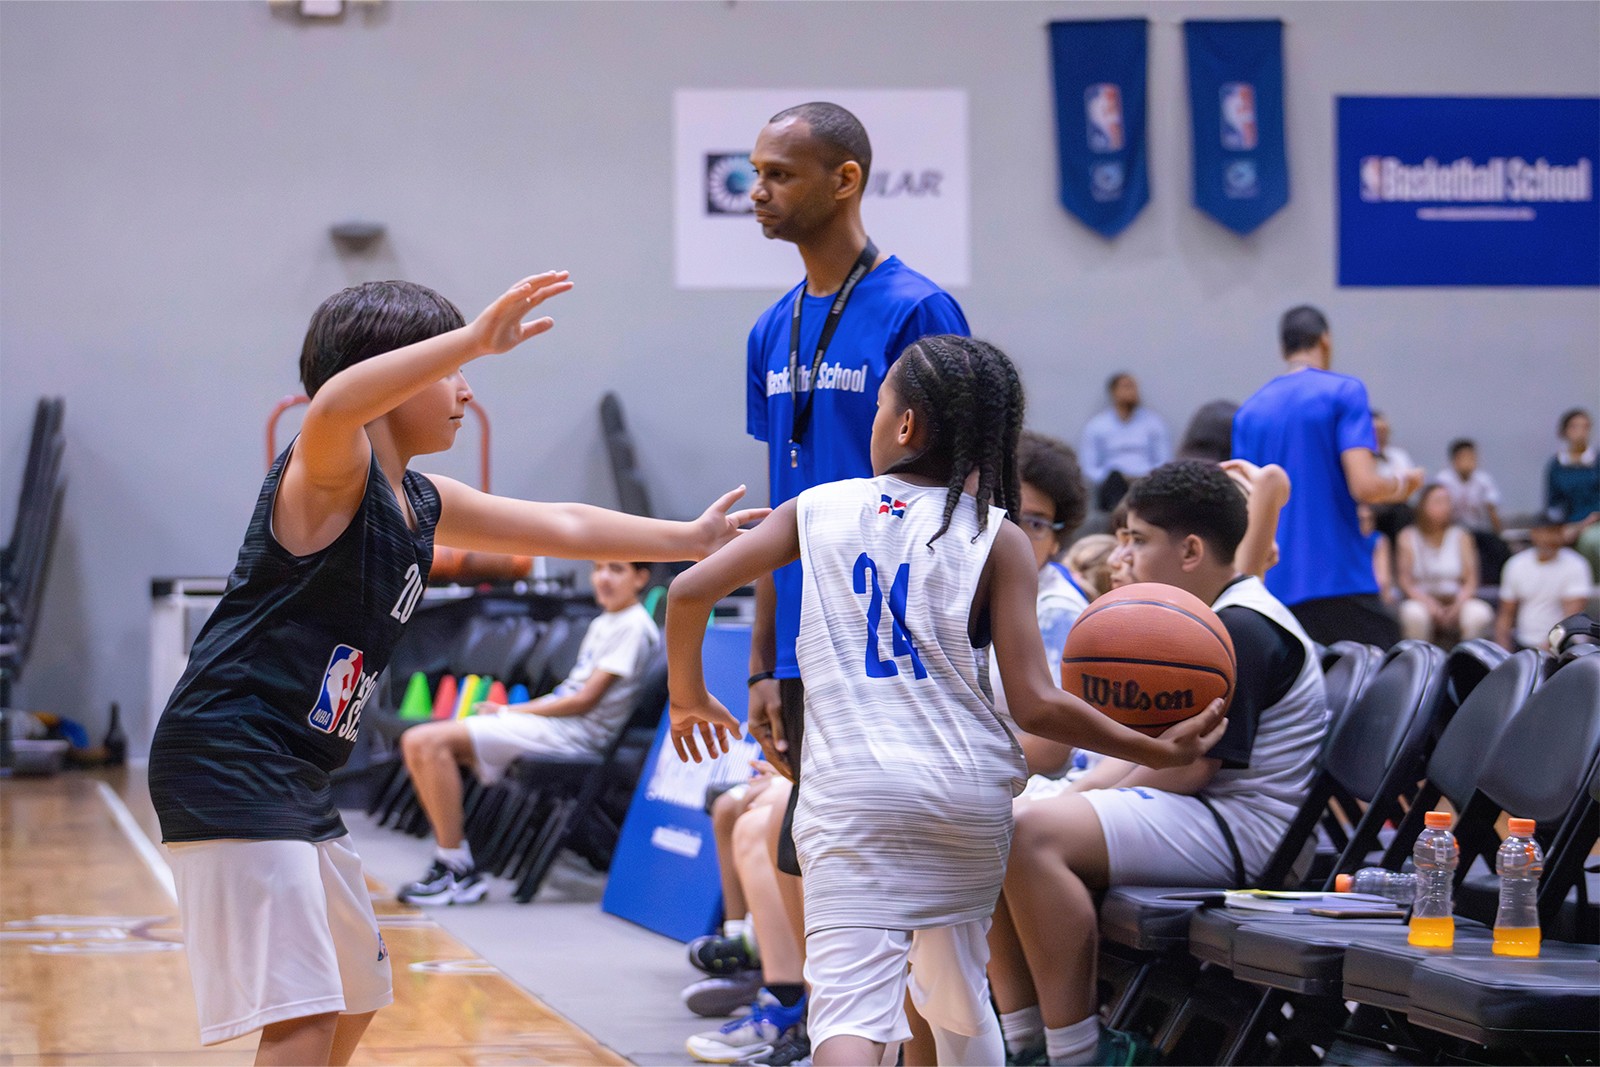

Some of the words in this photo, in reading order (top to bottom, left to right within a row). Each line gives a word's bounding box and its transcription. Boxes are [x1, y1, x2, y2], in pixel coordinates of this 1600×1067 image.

[1507, 156, 1593, 202] School
[816, 361, 868, 393] School
[390, 563, 423, 624] 20
[852, 551, 928, 681] 24
[1081, 672, 1196, 711] Wilson
[312, 708, 332, 726] NBA
